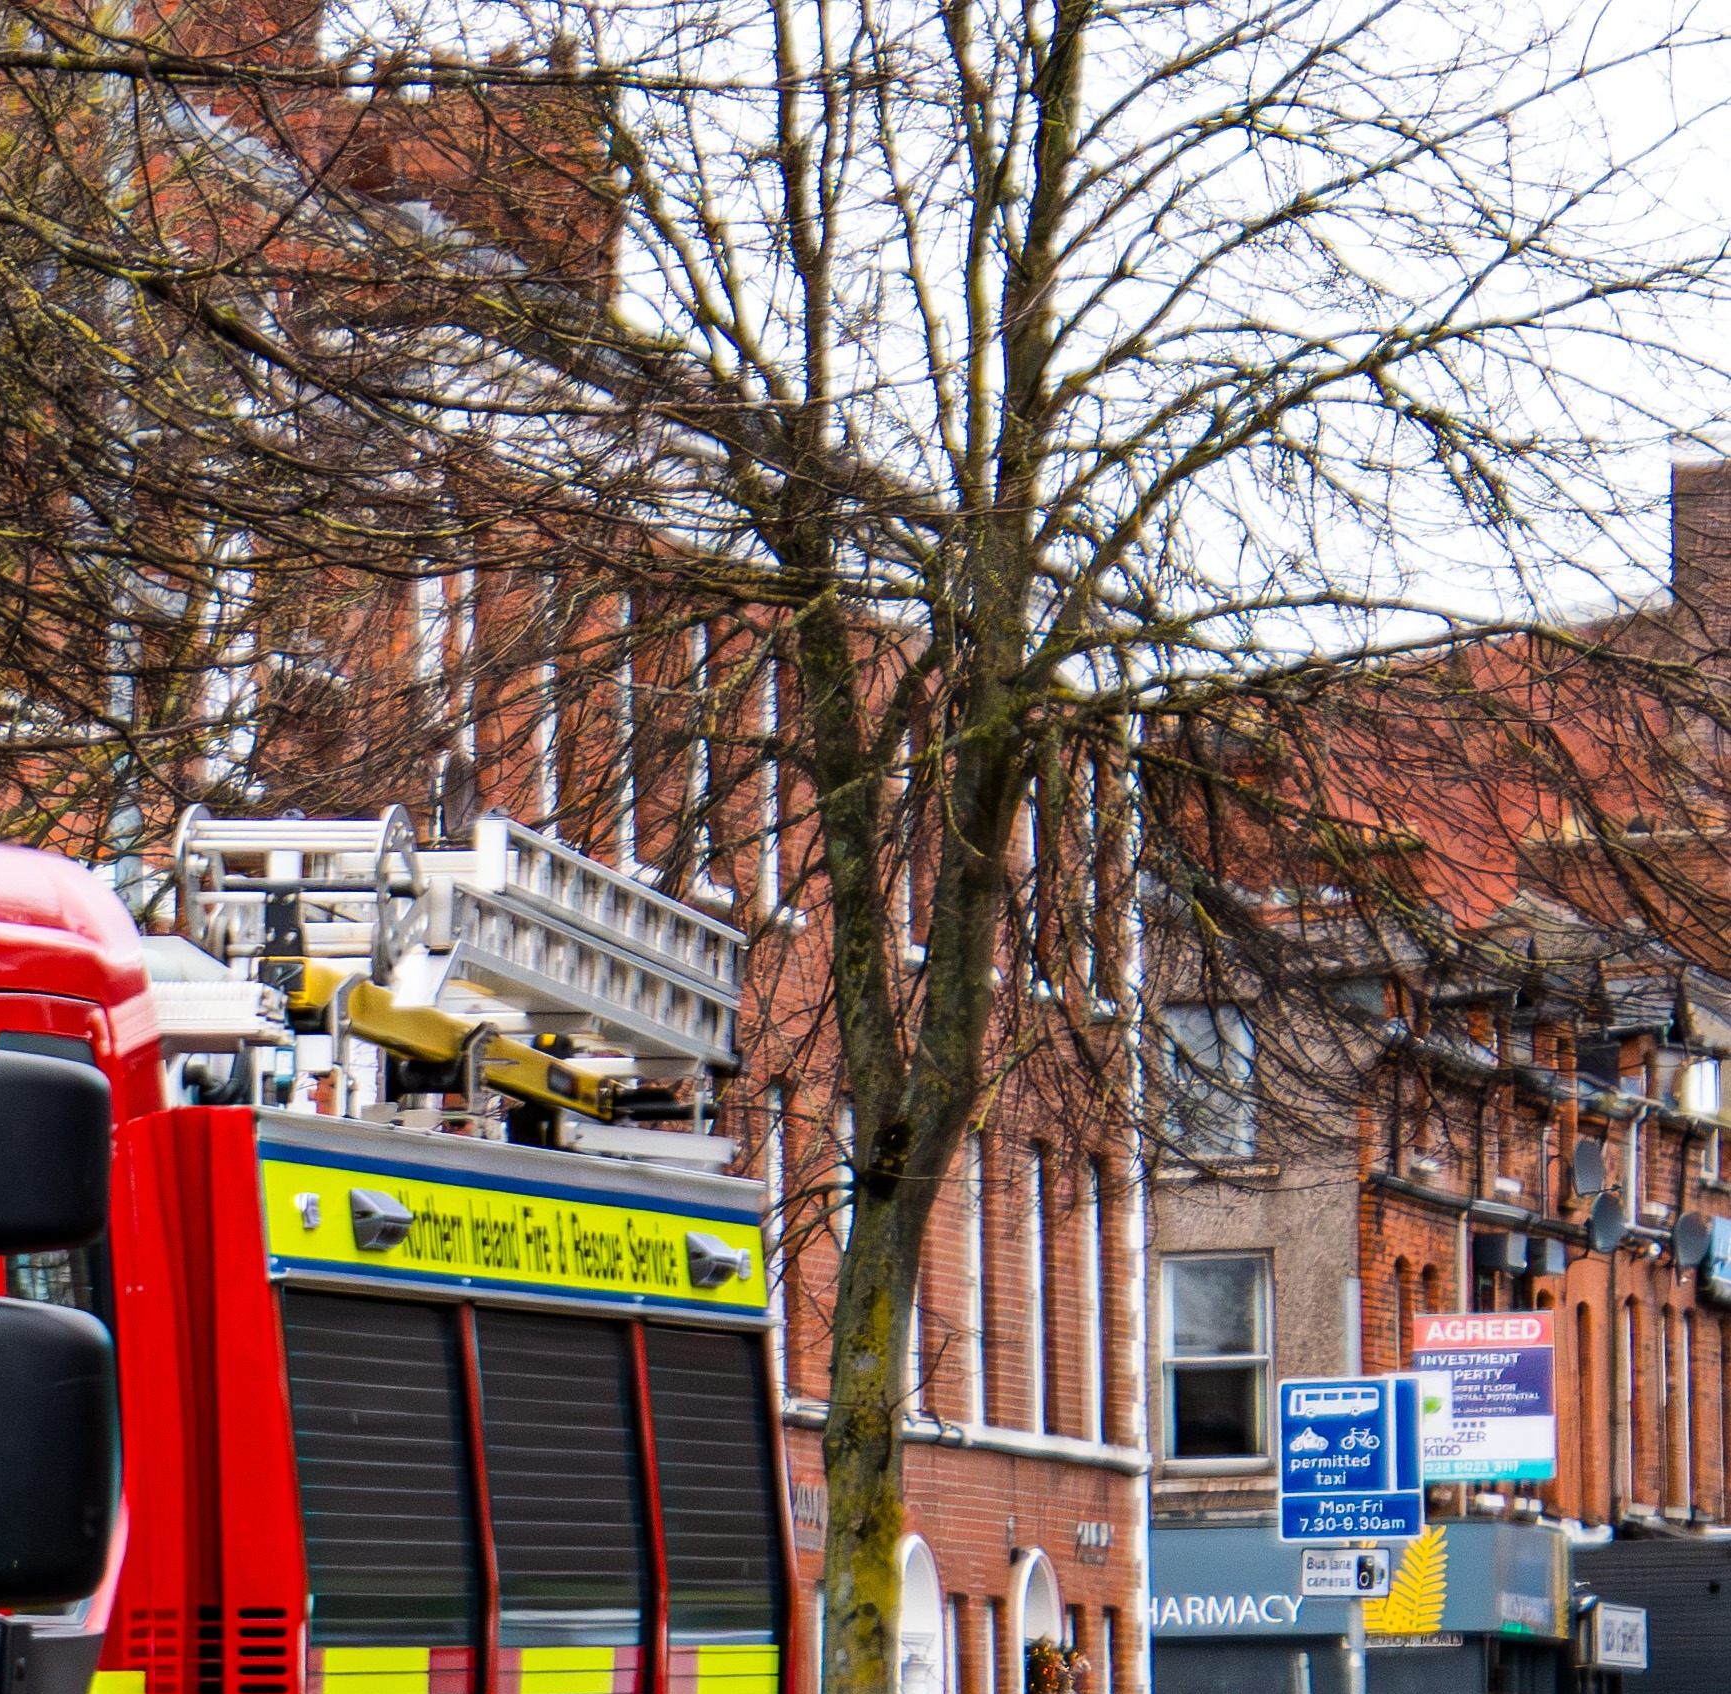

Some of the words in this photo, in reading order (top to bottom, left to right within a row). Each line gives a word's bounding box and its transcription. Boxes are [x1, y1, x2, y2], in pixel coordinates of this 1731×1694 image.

[468, 1199, 519, 1269] Ireland
[523, 1206, 552, 1274] Fire
[556, 1210, 570, 1275] &
[572, 1212, 624, 1281] Rescue
[627, 1217, 680, 1287] Service
[1425, 1319, 1542, 1342] AGREED
[1420, 1353, 1521, 1366] INVESTMENT
[1454, 1369, 1504, 1380] PERTY
[1424, 1445, 1462, 1457] KIDD
[1290, 1454, 1371, 1474] permitted
[1315, 1470, 1346, 1486] taxi
[1319, 1499, 1383, 1516] Mon-Fri
[1299, 1516, 1405, 1532] 7.30-9.30am
[1306, 1557, 1326, 1569] Bus
[1329, 1557, 1351, 1569] lane
[1307, 1577, 1351, 1587] cameras
